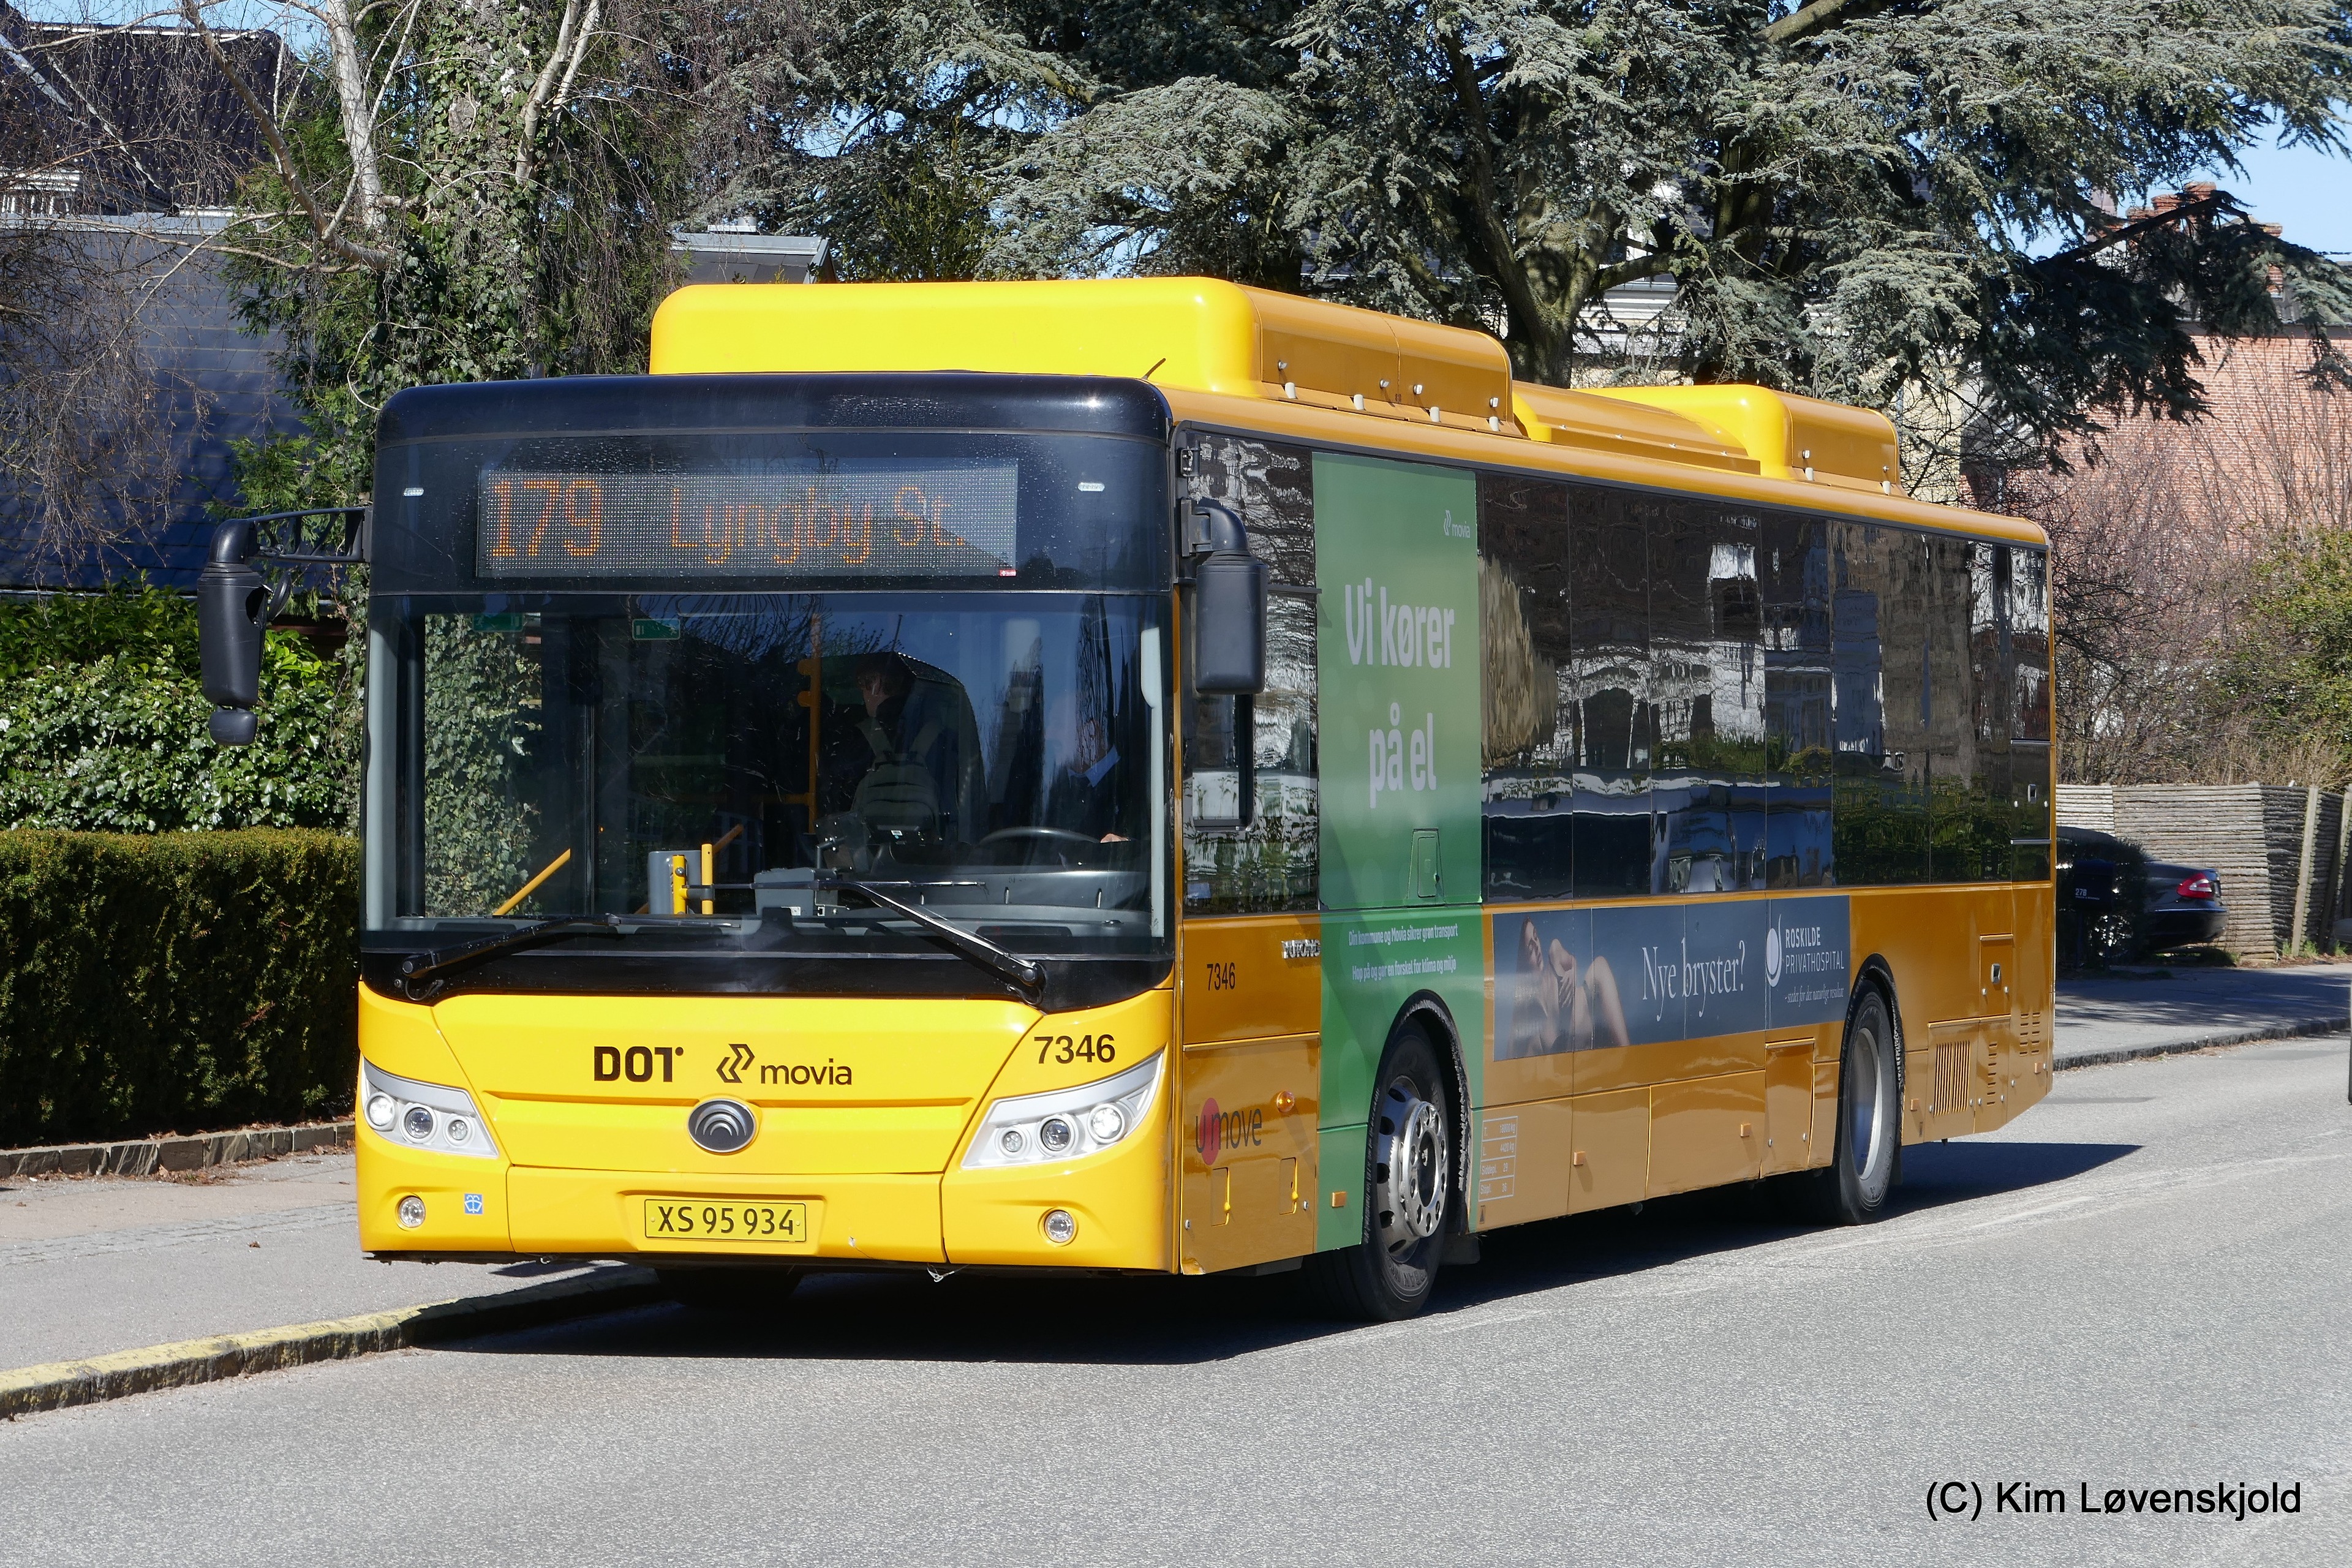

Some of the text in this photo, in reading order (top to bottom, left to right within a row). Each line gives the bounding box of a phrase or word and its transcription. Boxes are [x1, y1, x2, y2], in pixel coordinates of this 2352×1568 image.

[492, 480, 965, 564] 179 Lyngby St.
[1452, 520, 1471, 538] movia
[1344, 577, 1455, 668] Vi kører
[1369, 702, 1436, 809] på el
[1349, 930, 1358, 946] Din
[1358, 930, 1384, 945] kommune
[1384, 932, 1391, 945] og
[1392, 925, 1406, 942] Movia
[1407, 924, 1422, 941] sikrer
[1434, 923, 1458, 940] transport
[1785, 927, 1821, 948] ROSKILDE
[1281, 939, 1321, 959] YUTONG
[1785, 951, 1845, 974] PRIVATHOSPITAL
[1207, 963, 1236, 991] 7346
[1352, 965, 1363, 982] Hop
[1363, 962, 1370, 982] på
[1371, 966, 1378, 981] og
[1387, 964, 1394, 976] en
[1395, 960, 1413, 975] forskel
[1422, 957, 1436, 973] klima
[1436, 960, 1444, 974] og
[1642, 937, 1746, 1022] Nye bryster?
[594, 1046, 684, 1082] DOT
[1034, 1035, 1116, 1065] 7346
[761, 1058, 852, 1085] movia
[658, 1206, 794, 1235] XS 95 934
